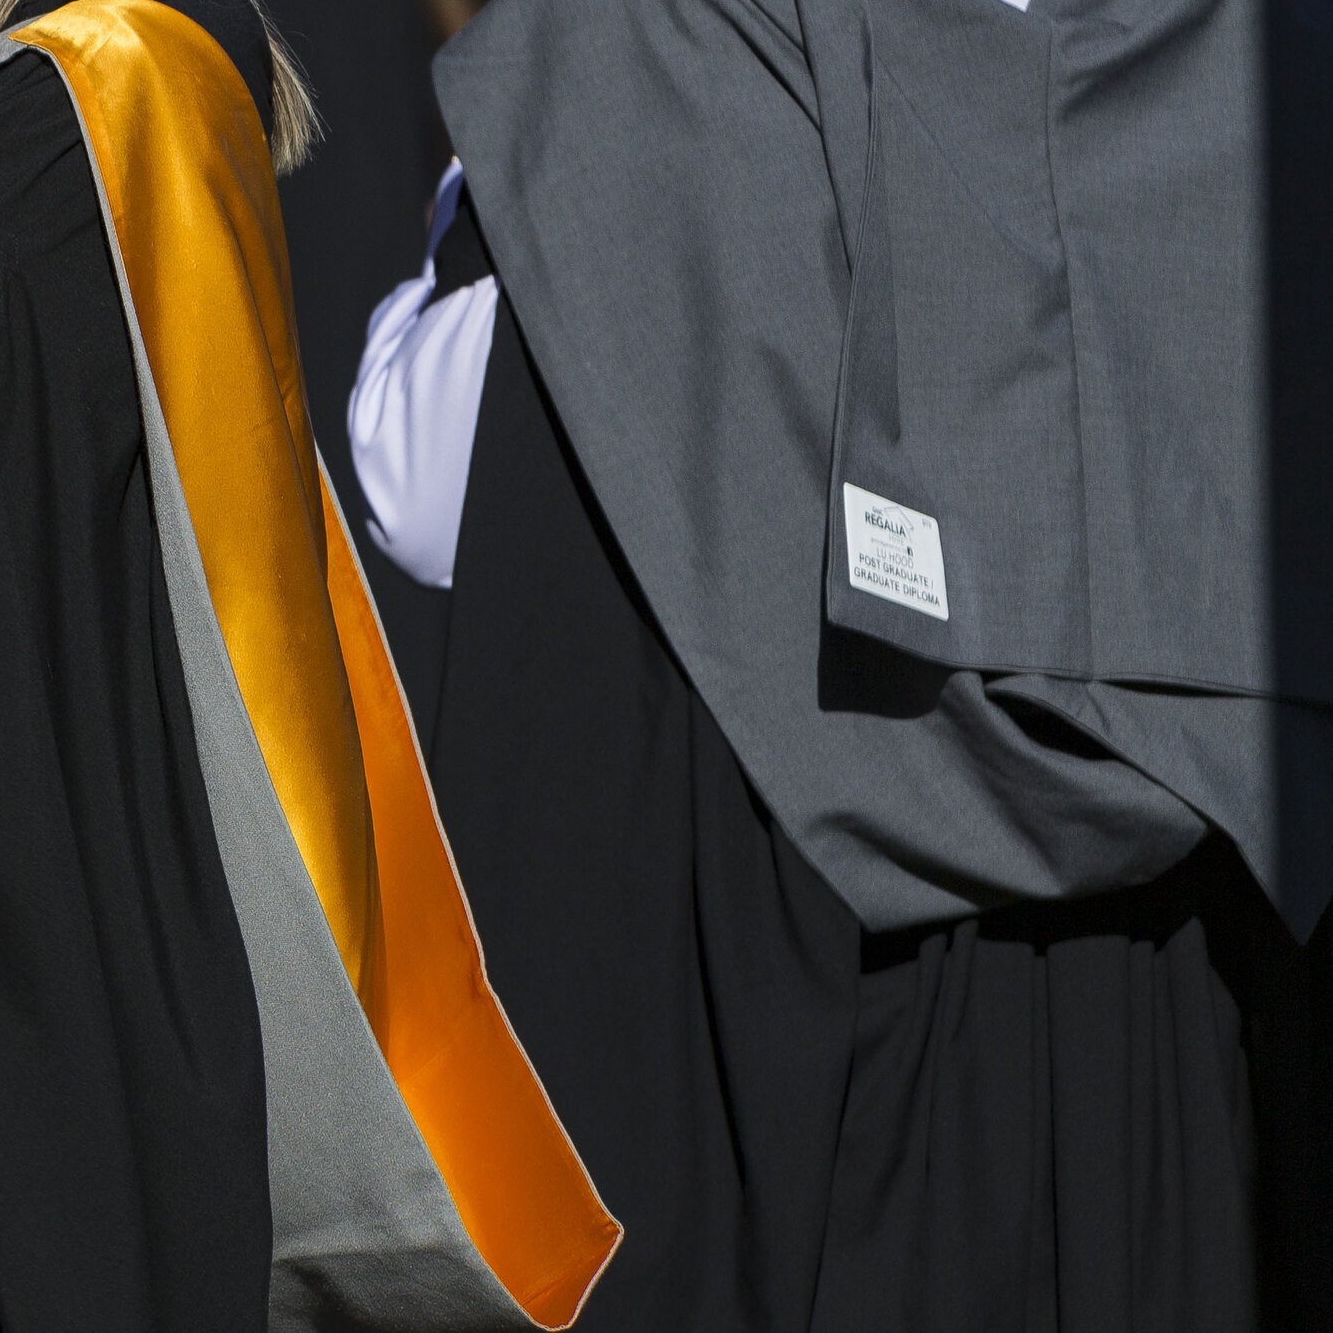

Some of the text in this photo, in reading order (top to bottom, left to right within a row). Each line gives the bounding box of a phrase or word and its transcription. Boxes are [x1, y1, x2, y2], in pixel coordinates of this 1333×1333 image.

[865, 510, 907, 538] REGALIA
[859, 553, 881, 571] POST
[883, 561, 929, 588] GRADUATE
[889, 551, 914, 569] HOOD
[853, 566, 941, 607] GRADUATE DIPLOMA
